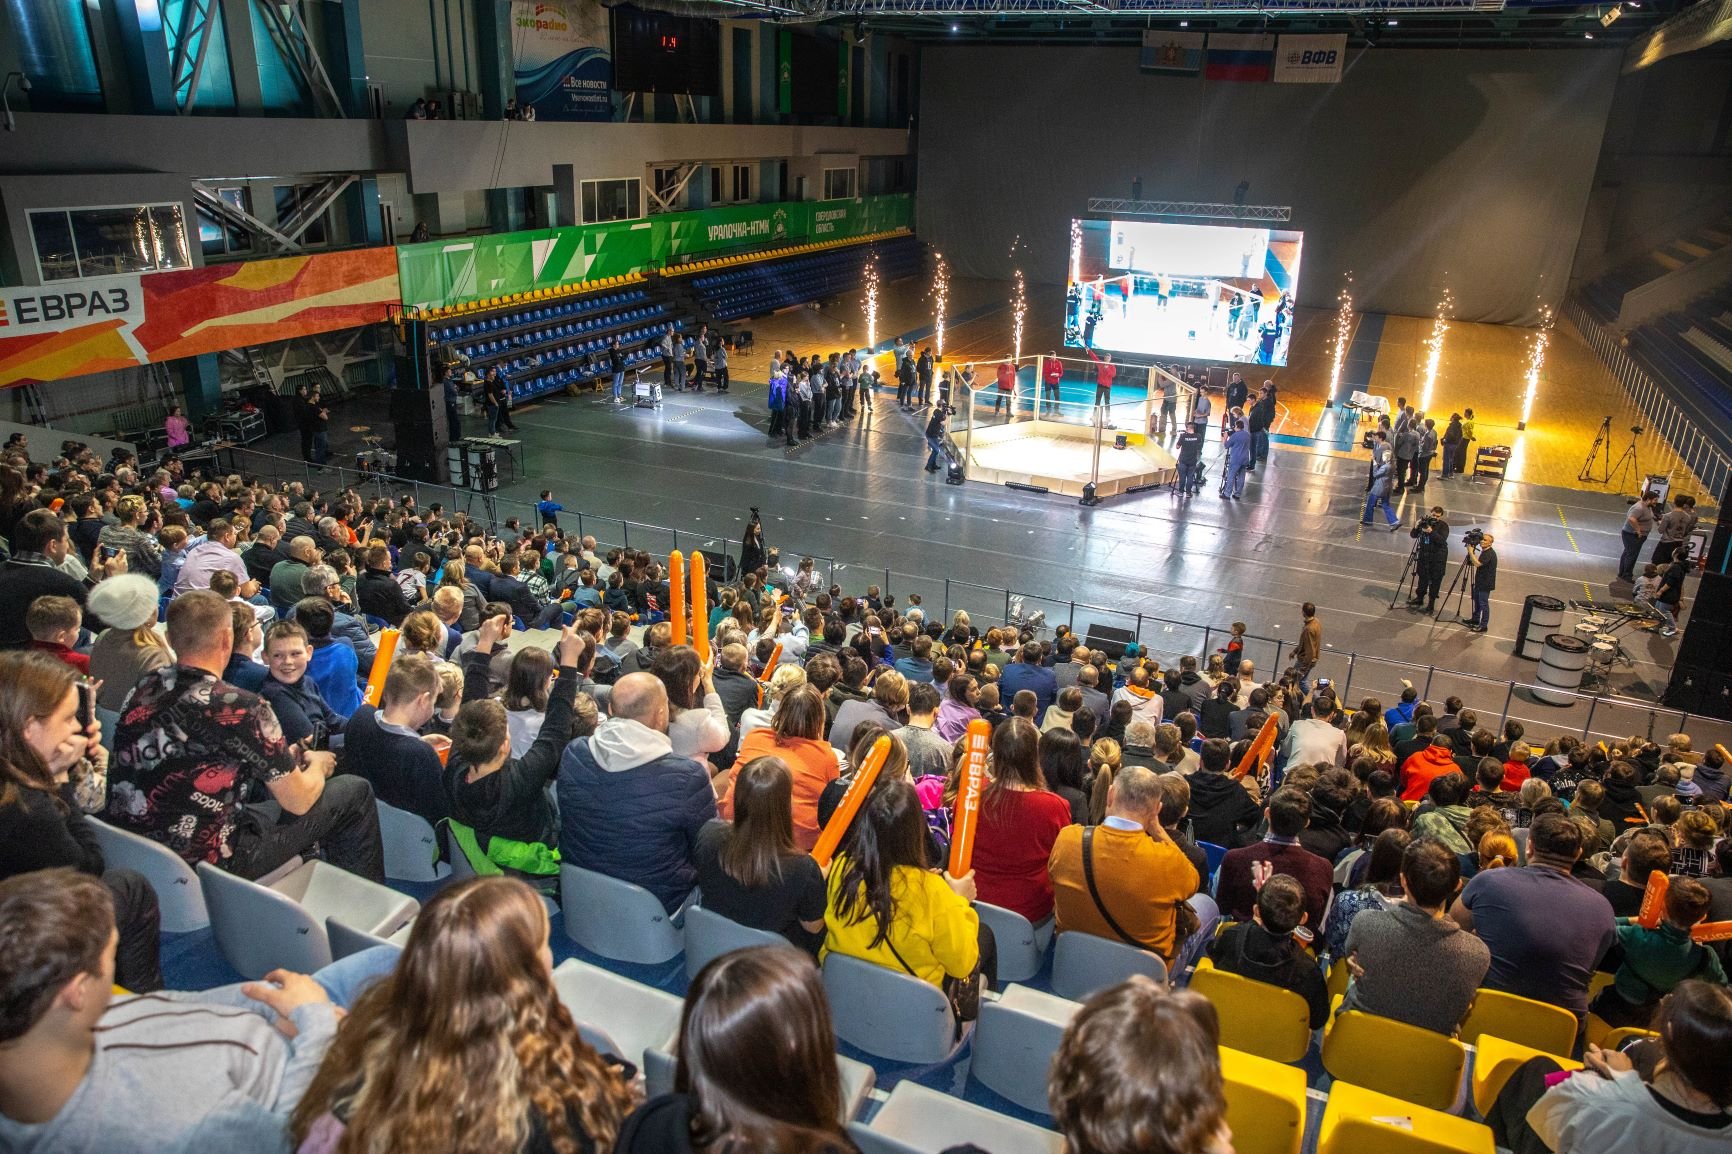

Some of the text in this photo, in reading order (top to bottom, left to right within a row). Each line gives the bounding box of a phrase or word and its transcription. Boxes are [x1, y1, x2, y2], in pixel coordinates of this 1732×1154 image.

[1301, 50, 1337, 65] ВФВ
[13, 288, 130, 325] ЕВРАЗ
[964, 751, 984, 811] ЕВРАЗ
